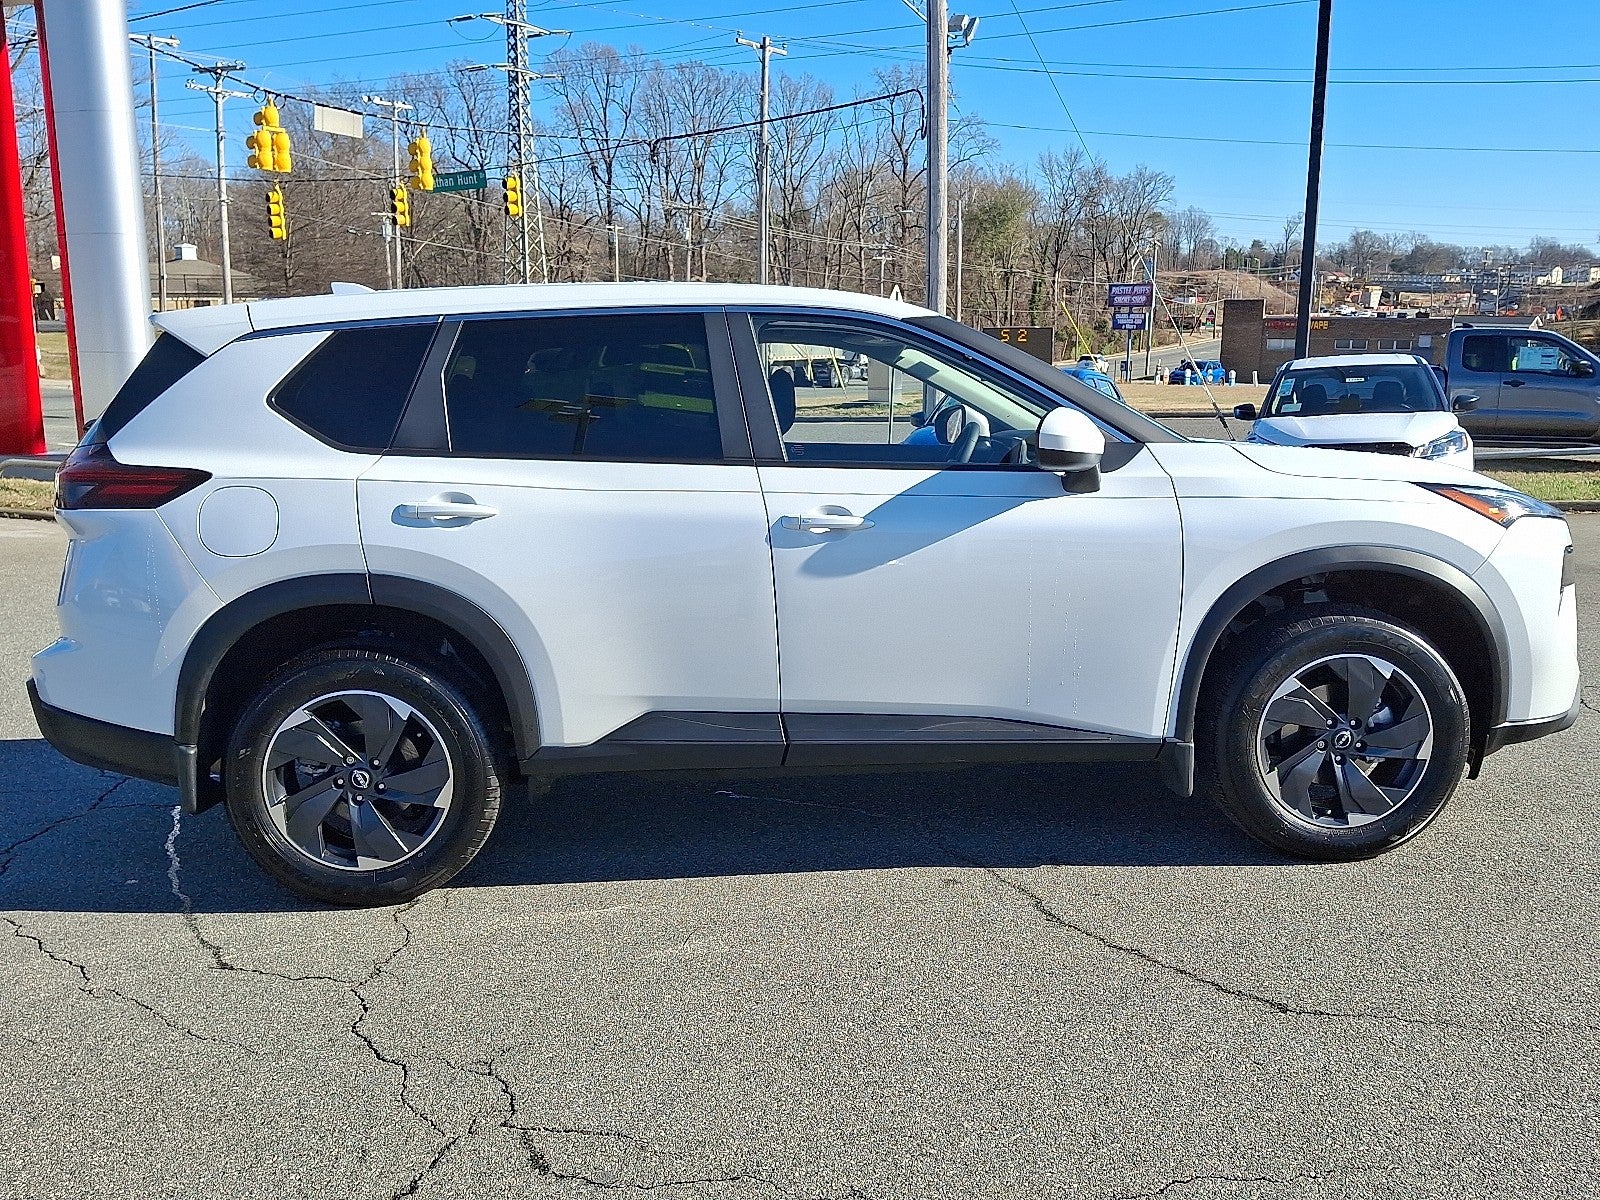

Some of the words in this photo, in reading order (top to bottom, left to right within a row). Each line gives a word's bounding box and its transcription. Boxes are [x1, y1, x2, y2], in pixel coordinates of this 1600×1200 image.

[433, 177, 454, 188] than
[457, 173, 478, 185] Hunt
[1131, 295, 1146, 303] SHOP
